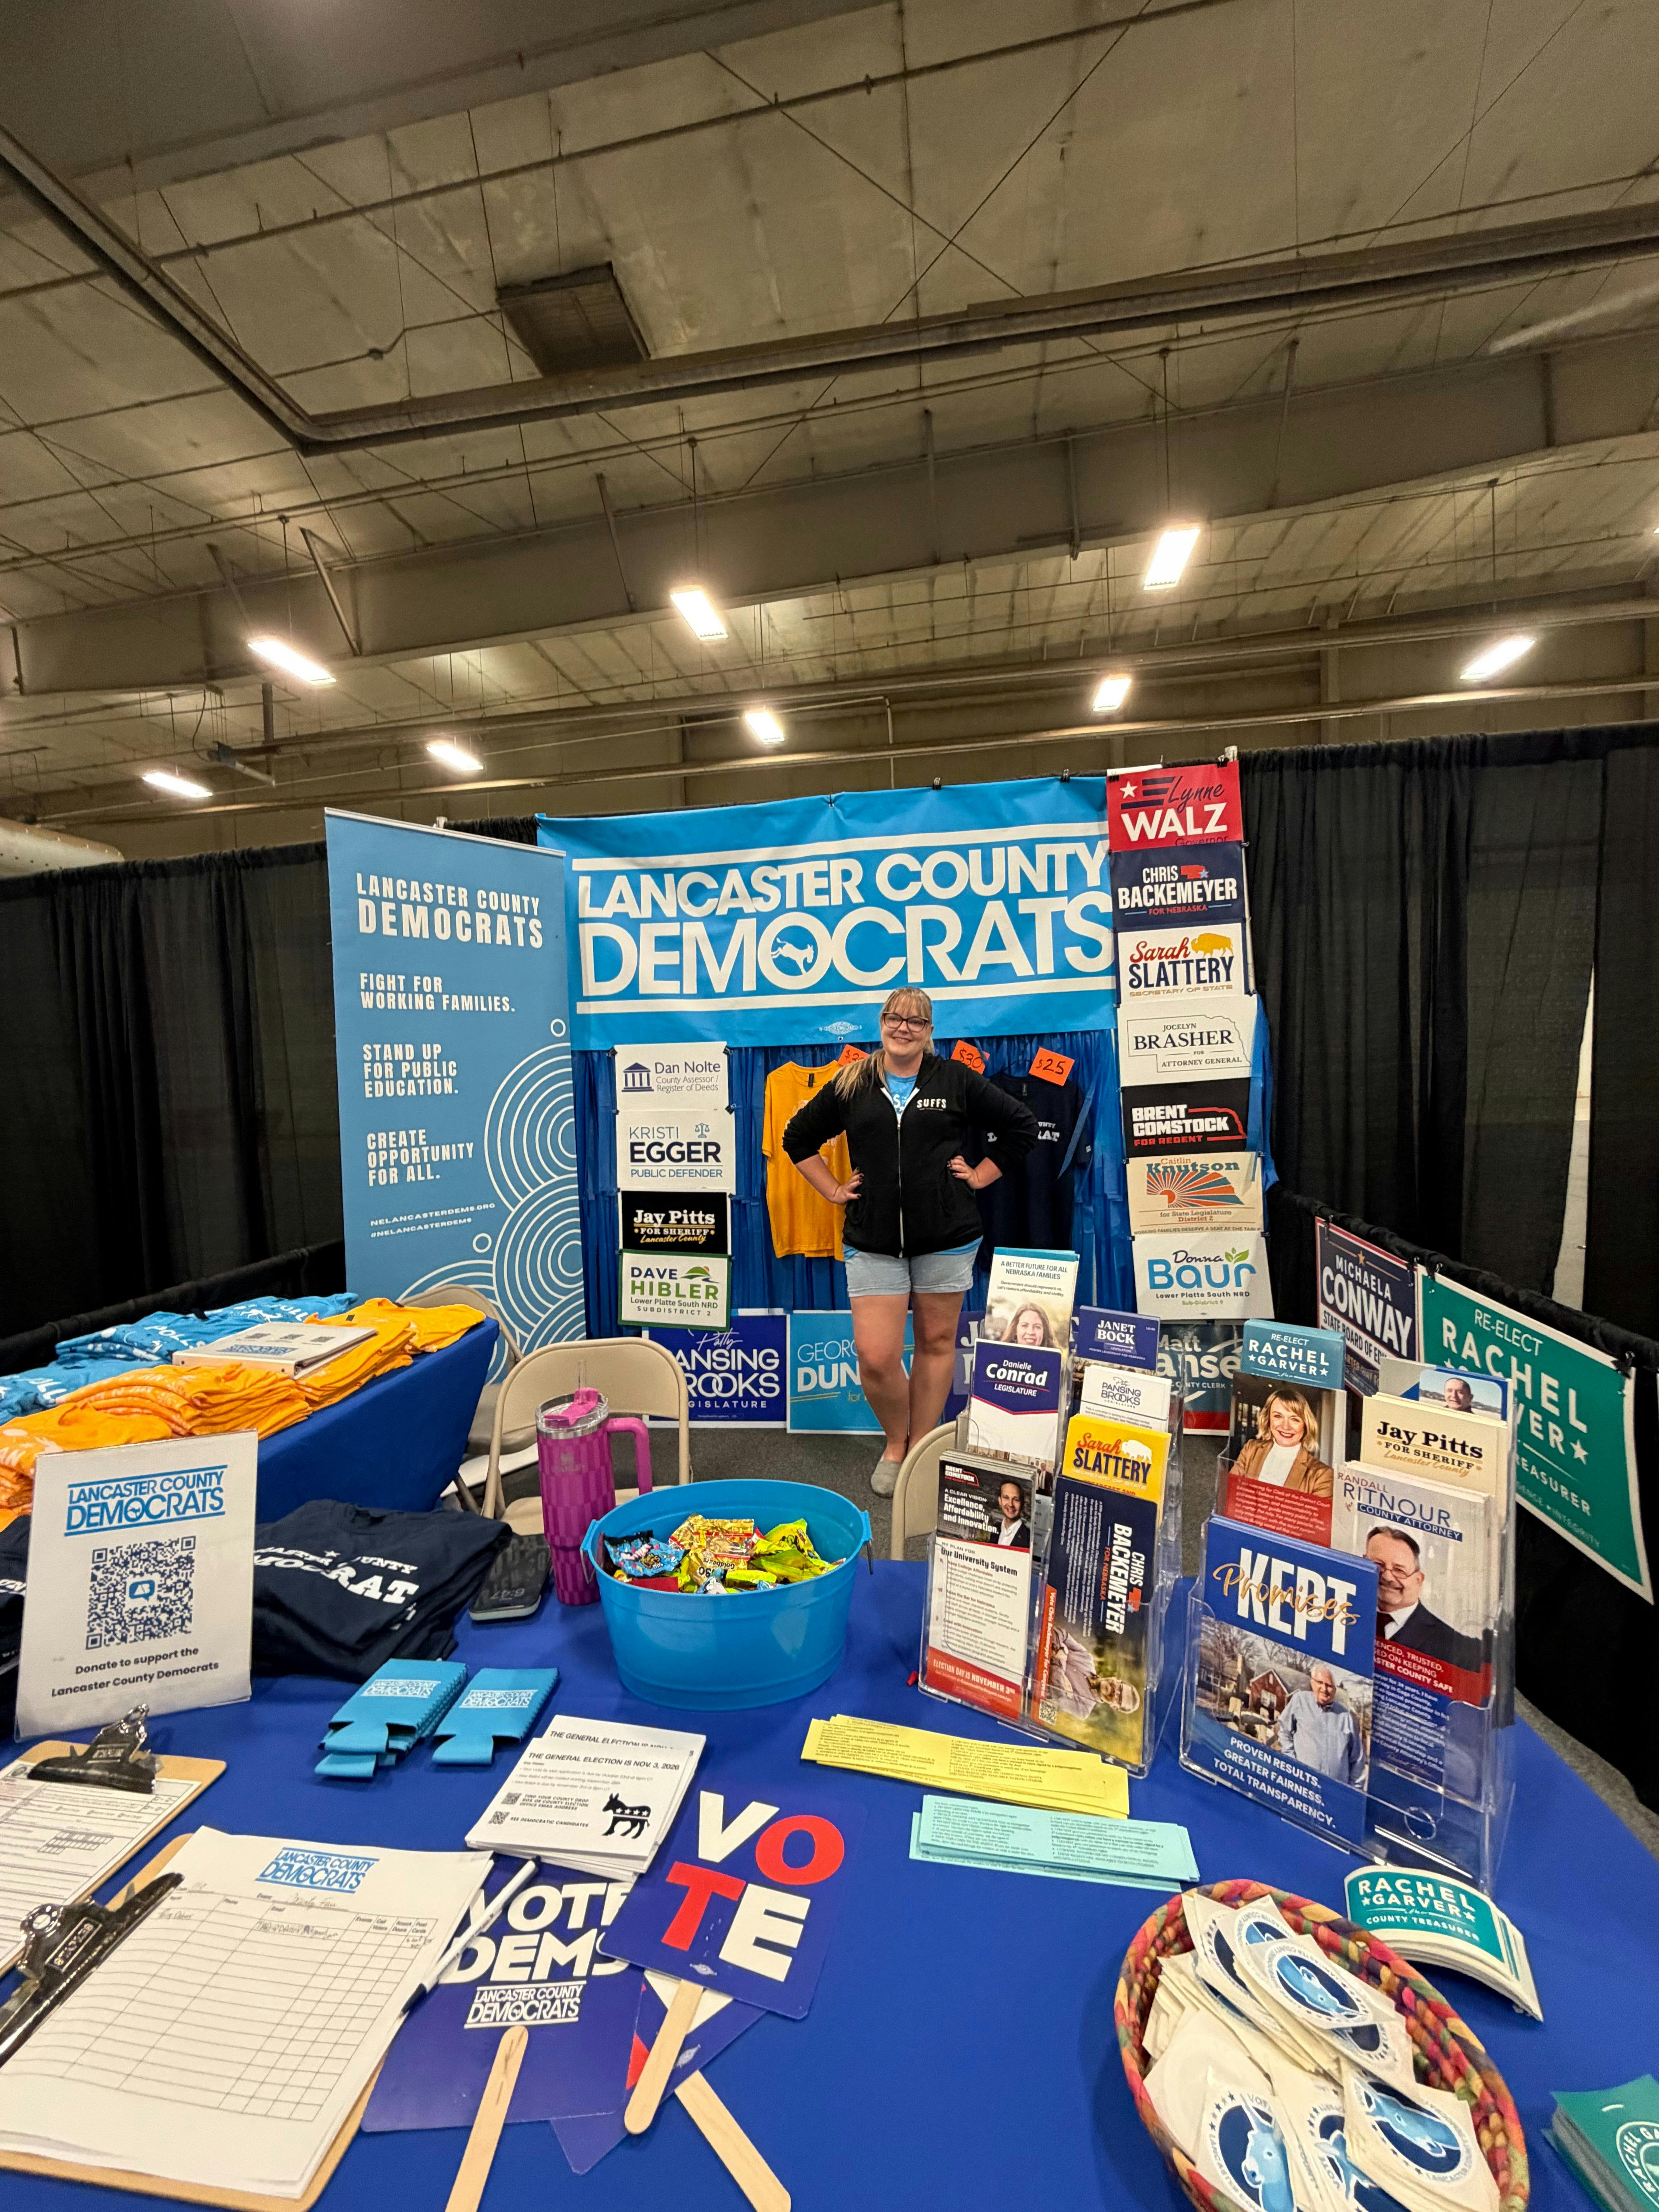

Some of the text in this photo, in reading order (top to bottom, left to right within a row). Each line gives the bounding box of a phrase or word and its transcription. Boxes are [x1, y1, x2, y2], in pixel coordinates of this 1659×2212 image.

[1168, 776, 1225, 813] Lynne
[1121, 803, 1227, 842] WALZ
[579, 839, 1109, 919] LANCASTER COUNTY
[1142, 865, 1178, 883] CHRIS
[356, 873, 539, 915] LANCASTER COUNTY
[1118, 878, 1237, 909] BACKEMEYER
[1149, 905, 1207, 915] FOR NEBRASKA
[359, 898, 543, 948] DEMOCRATS
[579, 891, 1115, 996] DEMOCRATS
[1130, 937, 1190, 963] Sarah
[360, 973, 442, 993] FIGHT FOR
[1129, 956, 1234, 989] SLATTERY
[361, 992, 515, 1012] WORKING FAMILIES.
[1130, 988, 1184, 997] SECRETARY
[1163, 1023, 1197, 1032] JOCELYN
[1133, 1029, 1234, 1051] BRASHER
[363, 1044, 442, 1061] STAND UP
[1162, 1057, 1242, 1068] ATTORNEY GENERAL
[364, 1061, 457, 1079] FOR PUBLIC
[655, 1061, 721, 1074] Dan Nolte
[1036, 1058, 1067, 1075] $25
[365, 1078, 459, 1097] EDUCATION.
[656, 1077, 681, 1085] County
[657, 1085, 684, 1093] Register
[917, 1098, 946, 1109] SUFFS
[1132, 1104, 1187, 1123] BRENT
[629, 1127, 678, 1139] KRISTI
[1133, 1116, 1229, 1137] COMSTOCK
[367, 1129, 426, 1150] CREATE
[368, 1143, 474, 1168] OPPORTUNITY
[630, 1142, 721, 1163] EGGER
[369, 1164, 440, 1186] FOR ALL.
[631, 1169, 723, 1177] PUBLIC DEFENDER
[1147, 1161, 1240, 1173] Knutson
[371, 1203, 495, 1226] NELANCASTERDEMS.ORG
[634, 1210, 715, 1227] Jay Pitts
[371, 1218, 472, 1238] #NELANCASTERDEMS
[1173, 1250, 1224, 1264] Donna
[631, 1267, 678, 1280] DAVE
[1147, 1259, 1256, 1290] Baur
[1336, 1255, 1391, 1301] MICHAELA
[631, 1280, 718, 1300] HIBLER
[637, 1306, 701, 1316] SUBDISTRICT
[1322, 1266, 1412, 1357] CONWAY
[1097, 1329, 1135, 1345] BOCK
[1098, 1320, 1136, 1333] JANET
[1474, 1308, 1544, 1355] RE-ELECT
[1271, 1333, 1309, 1346] RE-ELECT
[676, 1348, 779, 1370] ANSING
[1249, 1339, 1329, 1366] RACHEL
[986, 1363, 1048, 1386] Conrad
[1003, 1360, 1032, 1370] Danielle
[1258, 1356, 1317, 1376] GARVER
[1443, 1317, 1588, 1433] RACHEL
[684, 1372, 780, 1398] ROOKS
[994, 1384, 1037, 1396] LEGISLATURE
[1103, 1382, 1141, 1397] PANSING
[1101, 1390, 1140, 1405] BROOKS
[1077, 1433, 1121, 1455] Sarah
[1377, 1421, 1483, 1458] Jay Pitts
[1073, 1448, 1151, 1484] SLATTERY
[1384, 1442, 1474, 1469] FOR SHERIFF
[69, 1470, 224, 1504] LANCASTER COUNTY
[1338, 1472, 1388, 1493] RANDALL
[66, 1487, 223, 1530] DEMOCRATS
[944, 1503, 989, 1523] Affordability
[945, 1494, 985, 1512] Excellence,
[1344, 1482, 1450, 1527] RITNOUR
[943, 1513, 999, 1534] and Innovation.
[1360, 1504, 1460, 1539] COUNTY ATTORNEY
[954, 1551, 1017, 1577] University System
[1130, 1551, 1145, 1587] CHRIS
[1106, 1523, 1132, 1634] BACKEMEYER
[1213, 1563, 1360, 1626] Promises
[1237, 1547, 1356, 1656] KEPT
[75, 1646, 199, 1674] Donate to support the
[1403, 1657, 1436, 1678] KEEPING
[52, 1661, 219, 1697] Lancaster County Democrats
[1398, 1666, 1431, 1685] COUNTY
[362, 1686, 433, 1696] DEMOCRATS
[463, 1697, 531, 1706] DEMOCRATS
[583, 1756, 622, 1765] ELECTION
[1230, 1736, 1321, 1788] PROVEN RESULTS.
[1224, 1749, 1325, 1807] GREATER FAIRNESS.
[1214, 1757, 1336, 1828] TOTAL TRANSPARENCY.
[276, 1851, 374, 1872] LANCASTER COUNTY
[259, 1860, 366, 1889] DEMOCRATS
[1358, 1877, 1475, 1911] RACHEL
[1373, 1893, 1466, 1918] GARVER
[1366, 1916, 1480, 1941] COUNTY TREASURER
[475, 1985, 583, 2003] LANCASTER COUNTY
[467, 1998, 580, 2024] DEMOCRATS
